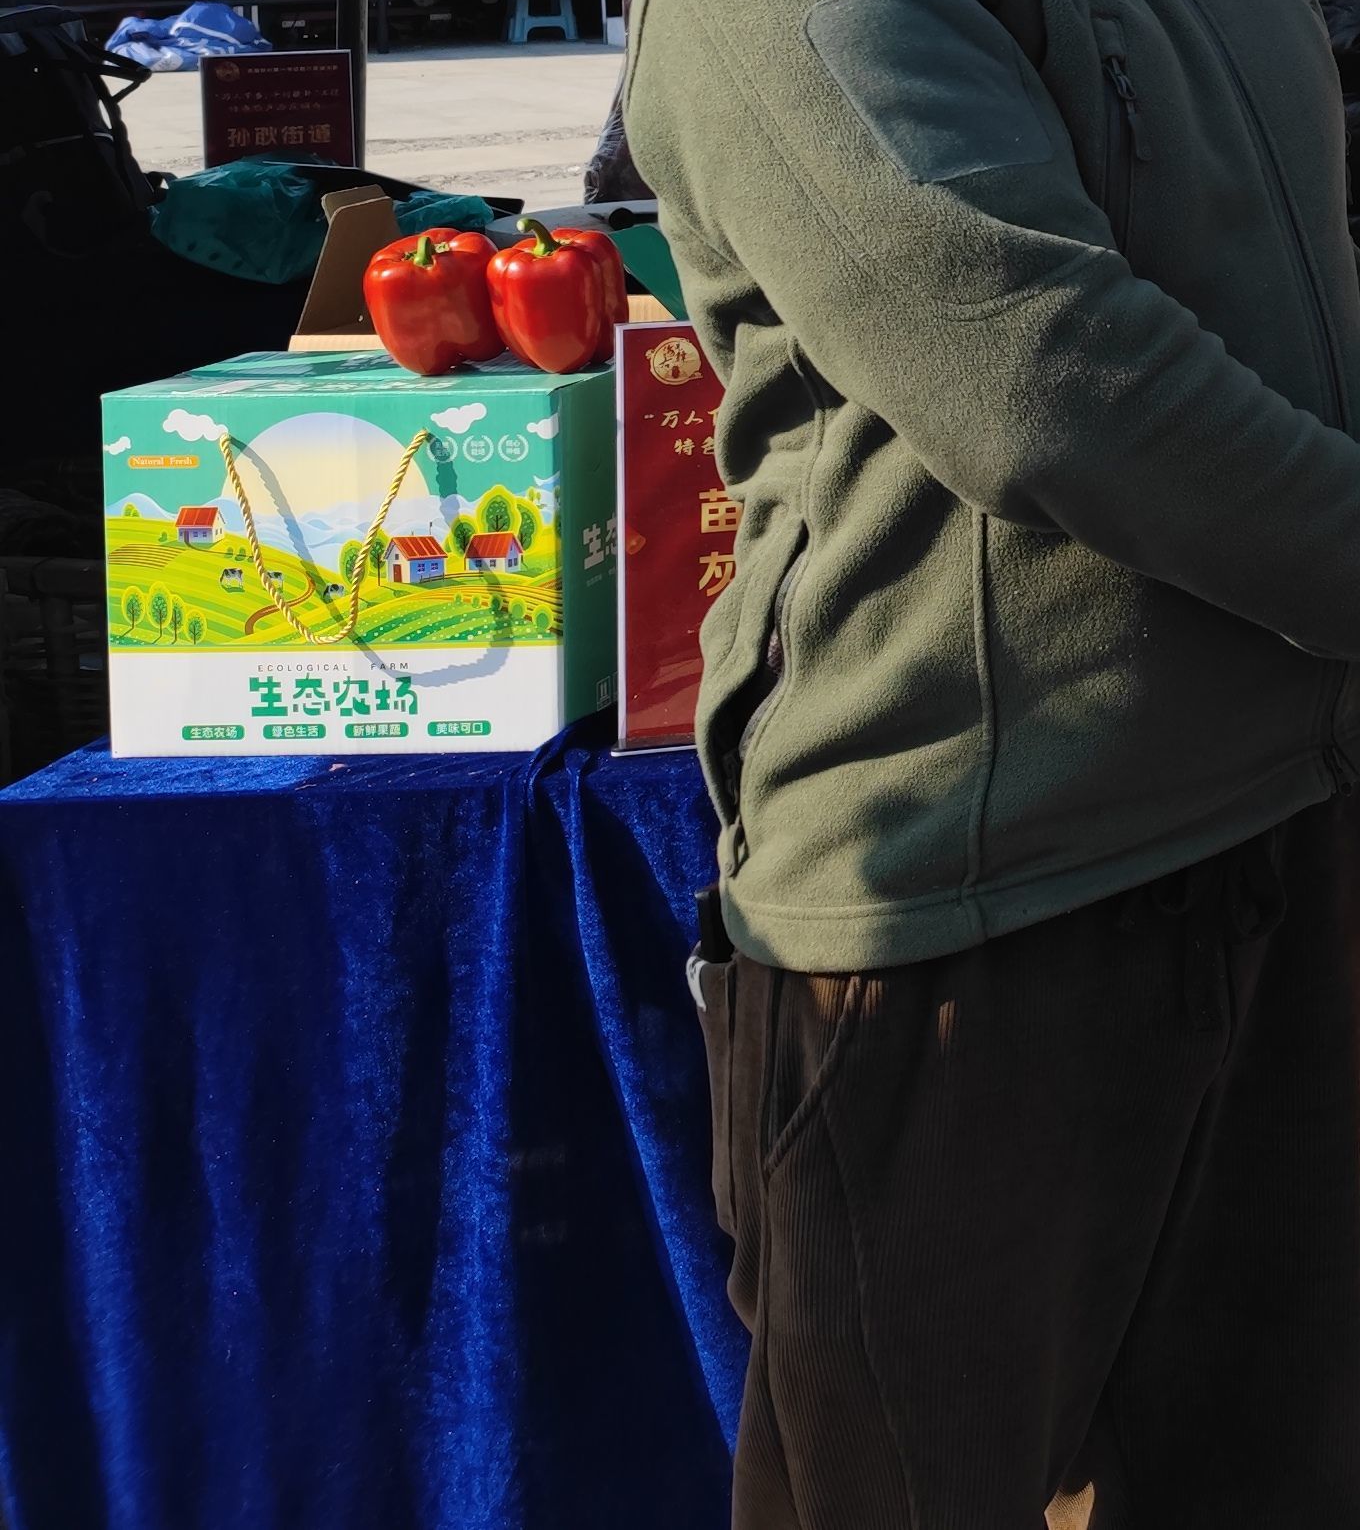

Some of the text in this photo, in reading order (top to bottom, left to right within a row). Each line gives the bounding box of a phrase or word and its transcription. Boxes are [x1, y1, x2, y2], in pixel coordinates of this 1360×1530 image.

[132, 456, 193, 466] Natural Fresh
[257, 661, 410, 672] ECOLOGICAL FARM
[249, 673, 419, 718] 生态农场
[189, 722, 484, 740] 生态农场 绿色生活 新鲜果蔬 美味可口
